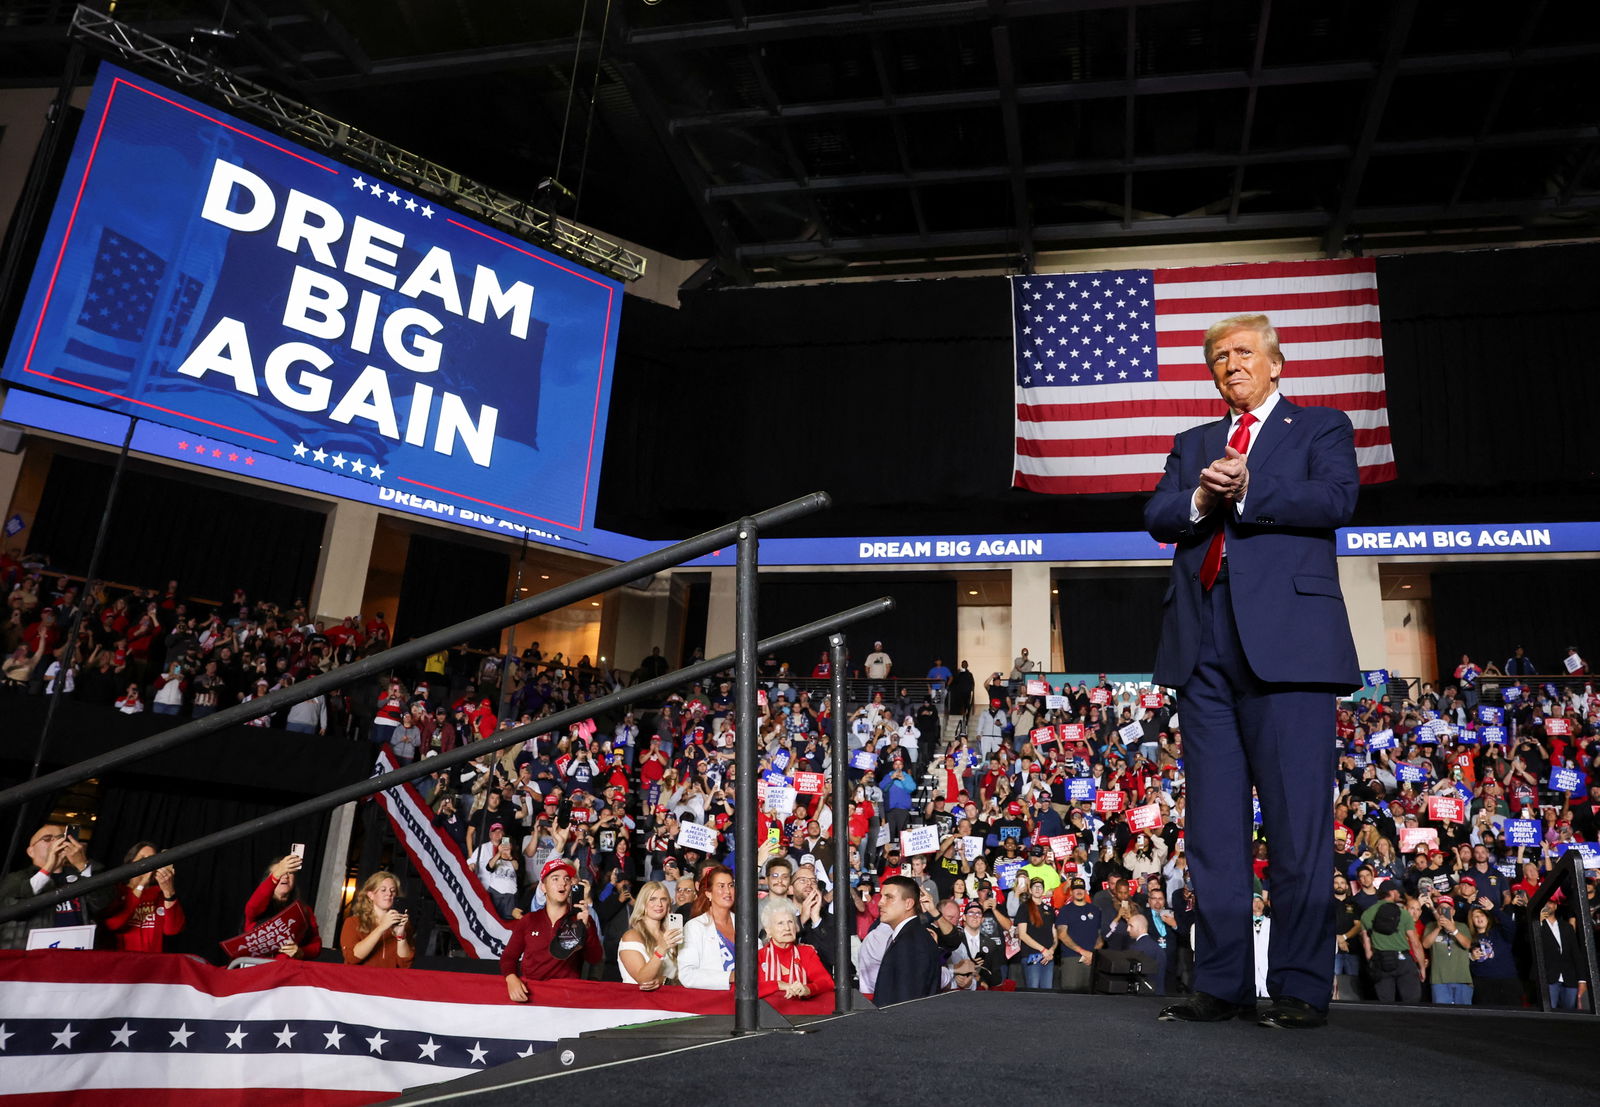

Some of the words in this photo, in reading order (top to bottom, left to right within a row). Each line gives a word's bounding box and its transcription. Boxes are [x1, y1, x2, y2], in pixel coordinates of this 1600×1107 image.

[201, 158, 534, 340] DREAM
[282, 264, 444, 374] BIG
[177, 316, 498, 468] AGAIN
[859, 542, 931, 558] DREAM
[936, 540, 971, 556] BIG
[976, 539, 1042, 556] AGAIN
[1347, 531, 1428, 549] DREAM
[1432, 530, 1472, 548] BIG
[1477, 529, 1551, 546] AGAIN
[909, 834, 932, 842] AMERICA
[238, 918, 296, 952] AMERICA
[244, 918, 283, 942] MAKE
[248, 928, 291, 952] GREAT
